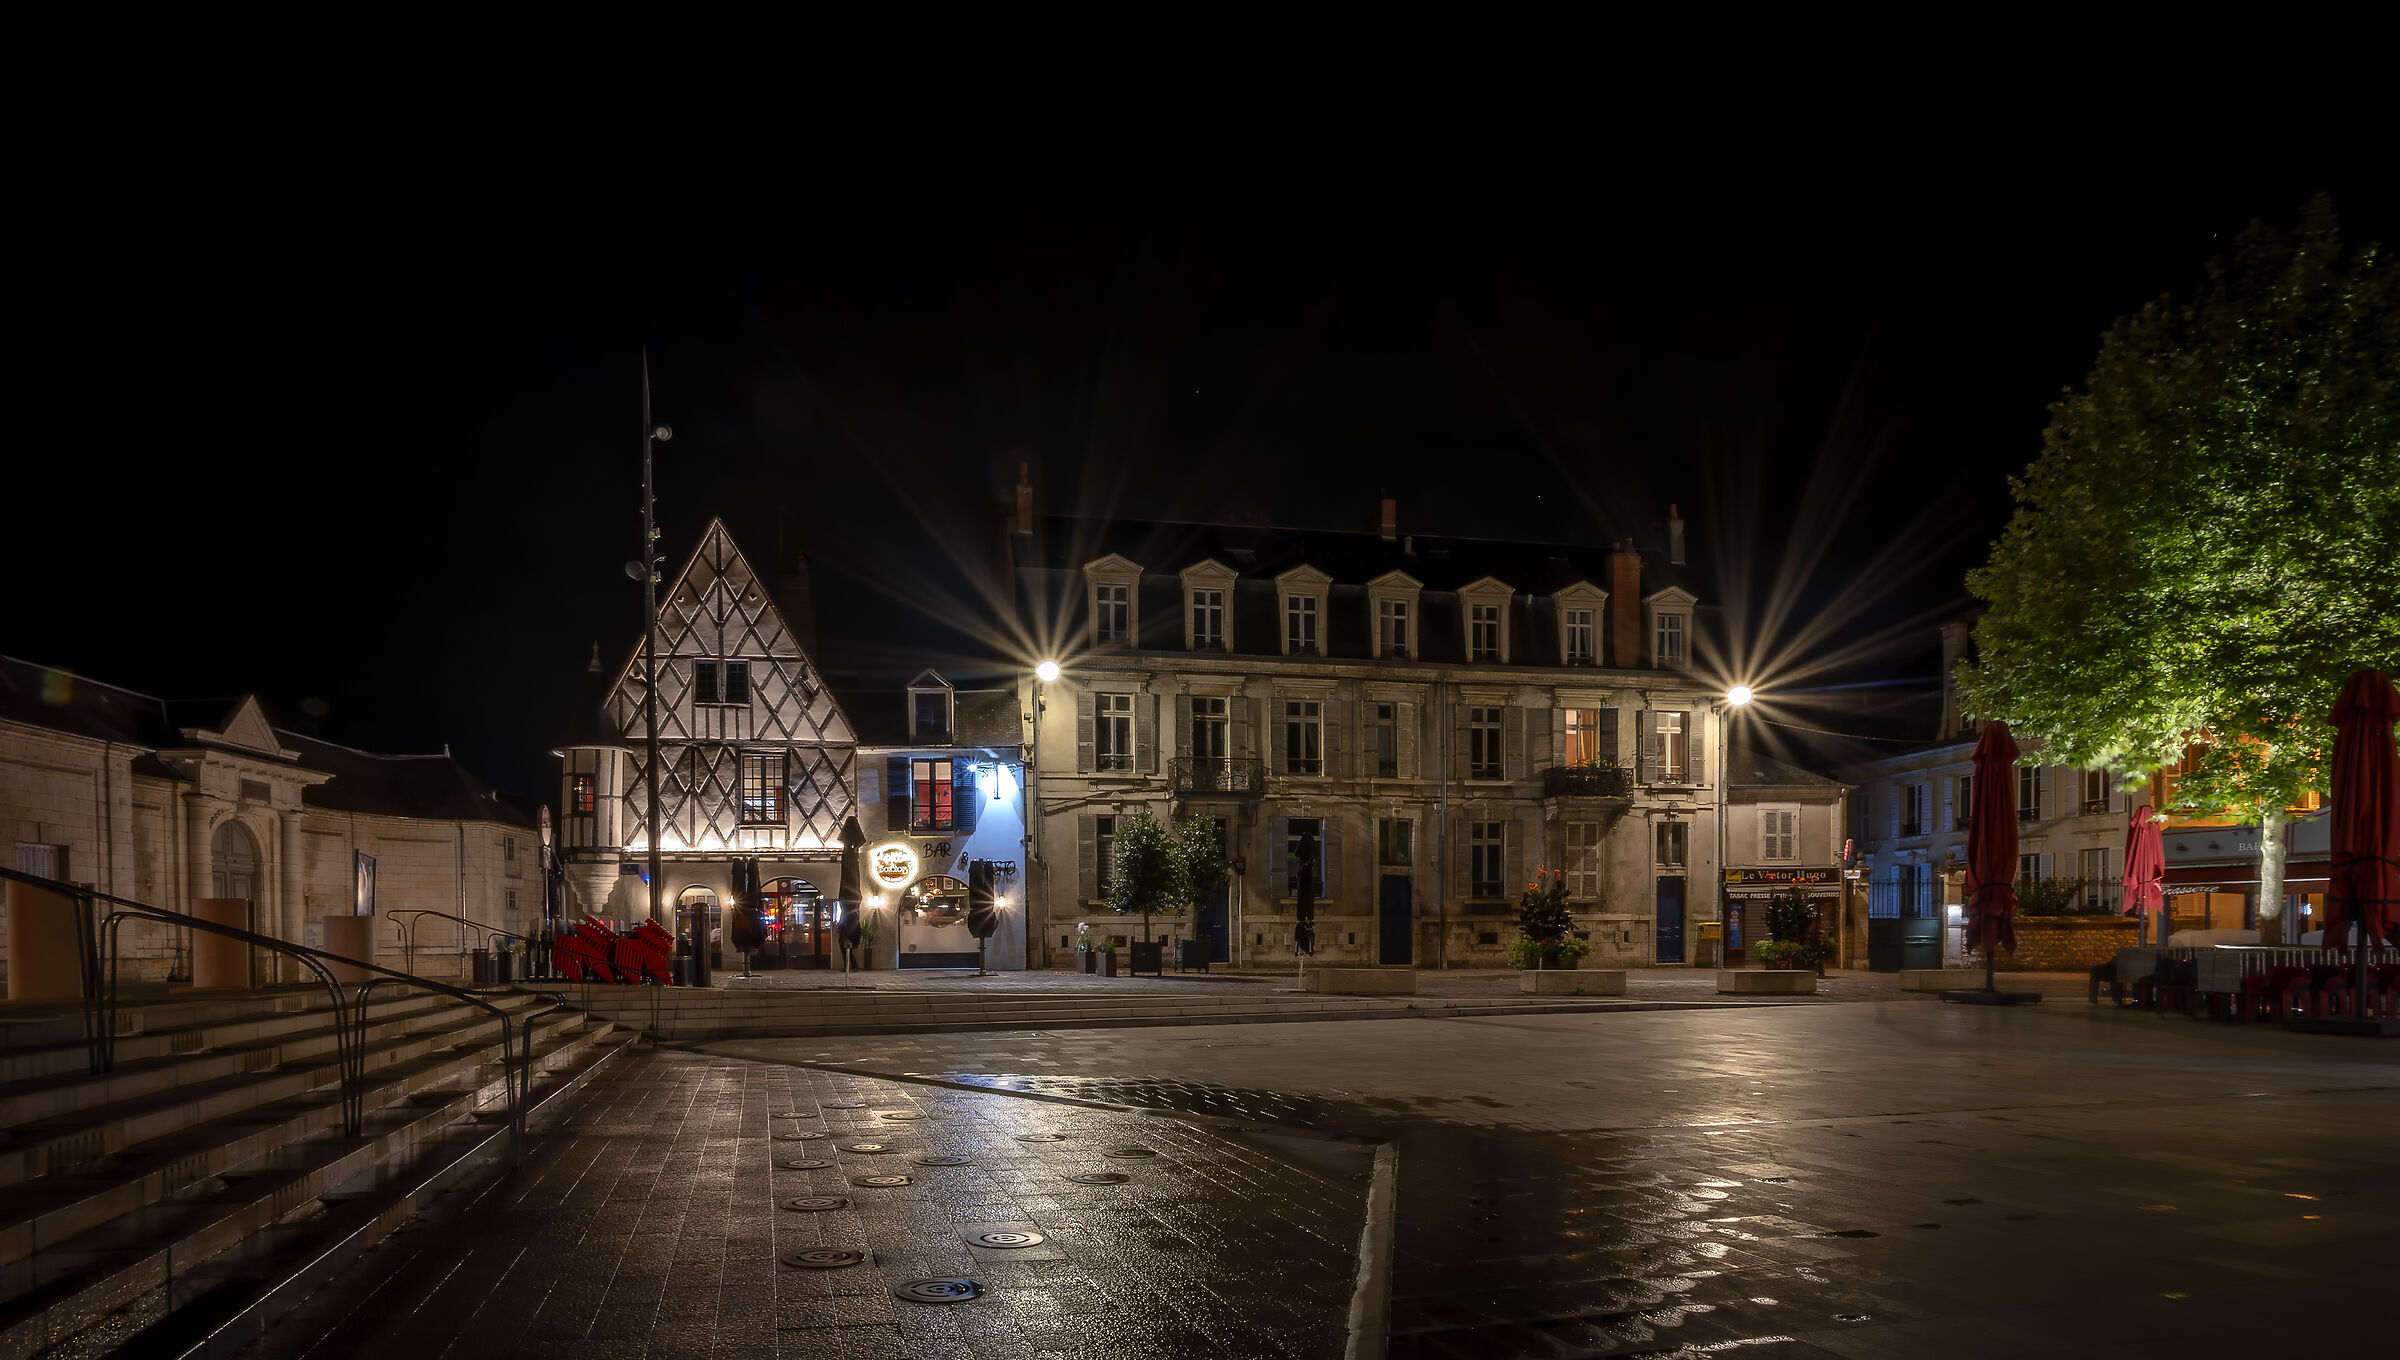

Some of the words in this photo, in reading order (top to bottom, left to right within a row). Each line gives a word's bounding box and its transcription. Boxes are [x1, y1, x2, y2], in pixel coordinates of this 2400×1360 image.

[923, 842, 952, 858] BAR
[960, 851, 969, 864] &
[1741, 870, 1755, 880] Le
